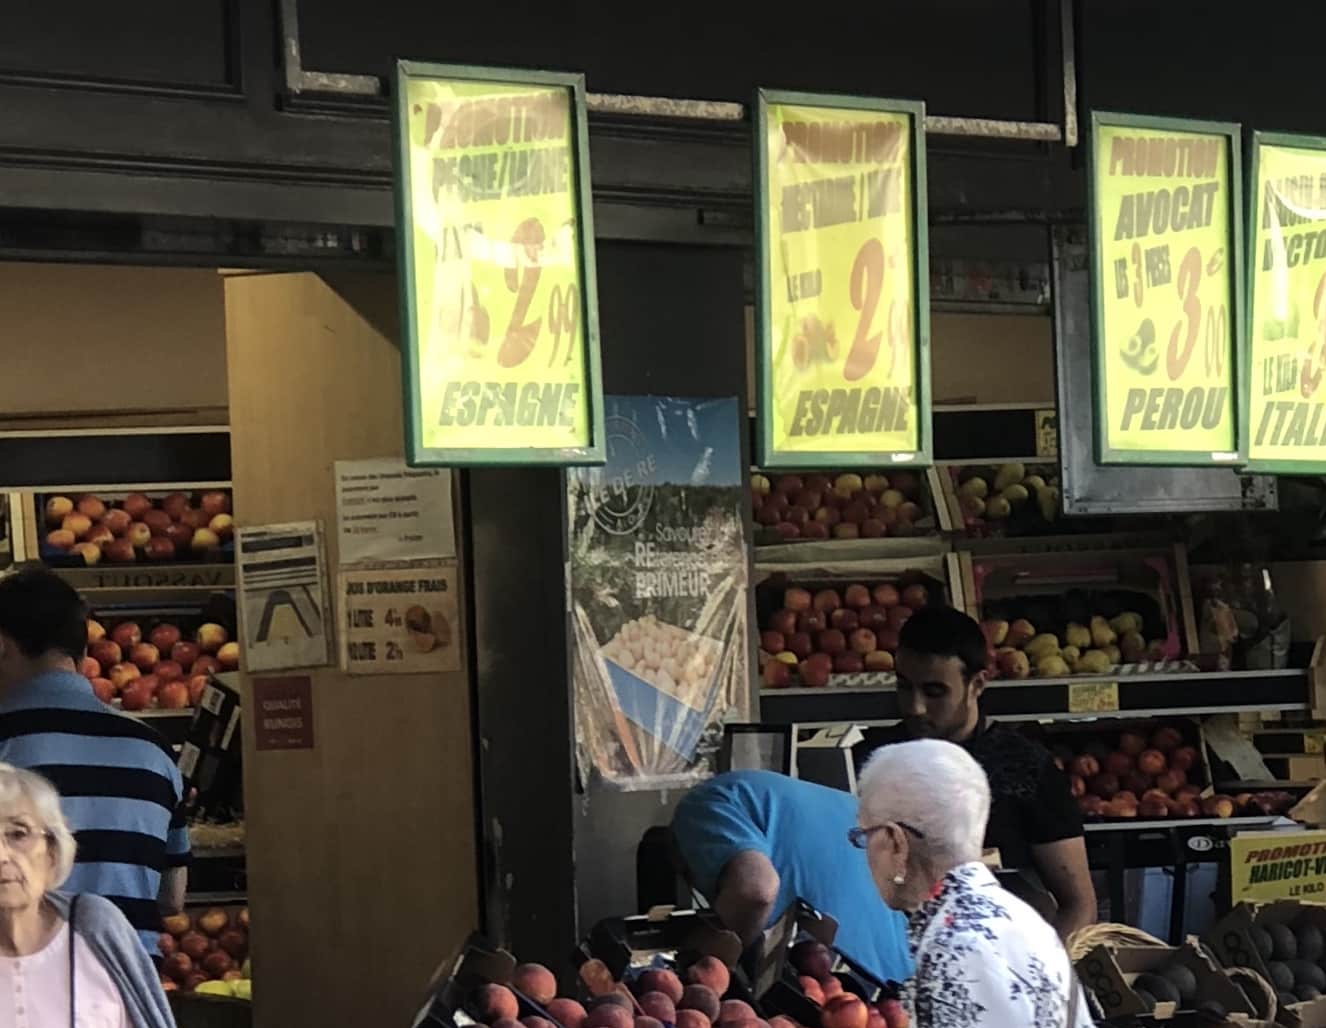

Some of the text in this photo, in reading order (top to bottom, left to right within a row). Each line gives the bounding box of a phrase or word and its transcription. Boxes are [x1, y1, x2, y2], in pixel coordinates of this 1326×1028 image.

[1109, 136, 1219, 177] PROMOTION
[1114, 182, 1218, 241] AVOCAT
[439, 381, 580, 427] ESPAGNE
[789, 385, 912, 437] ESPAGNE
[1120, 386, 1228, 431] PEROU
[418, 578, 449, 593] FRAIS
[1289, 885, 1301, 896] LE
